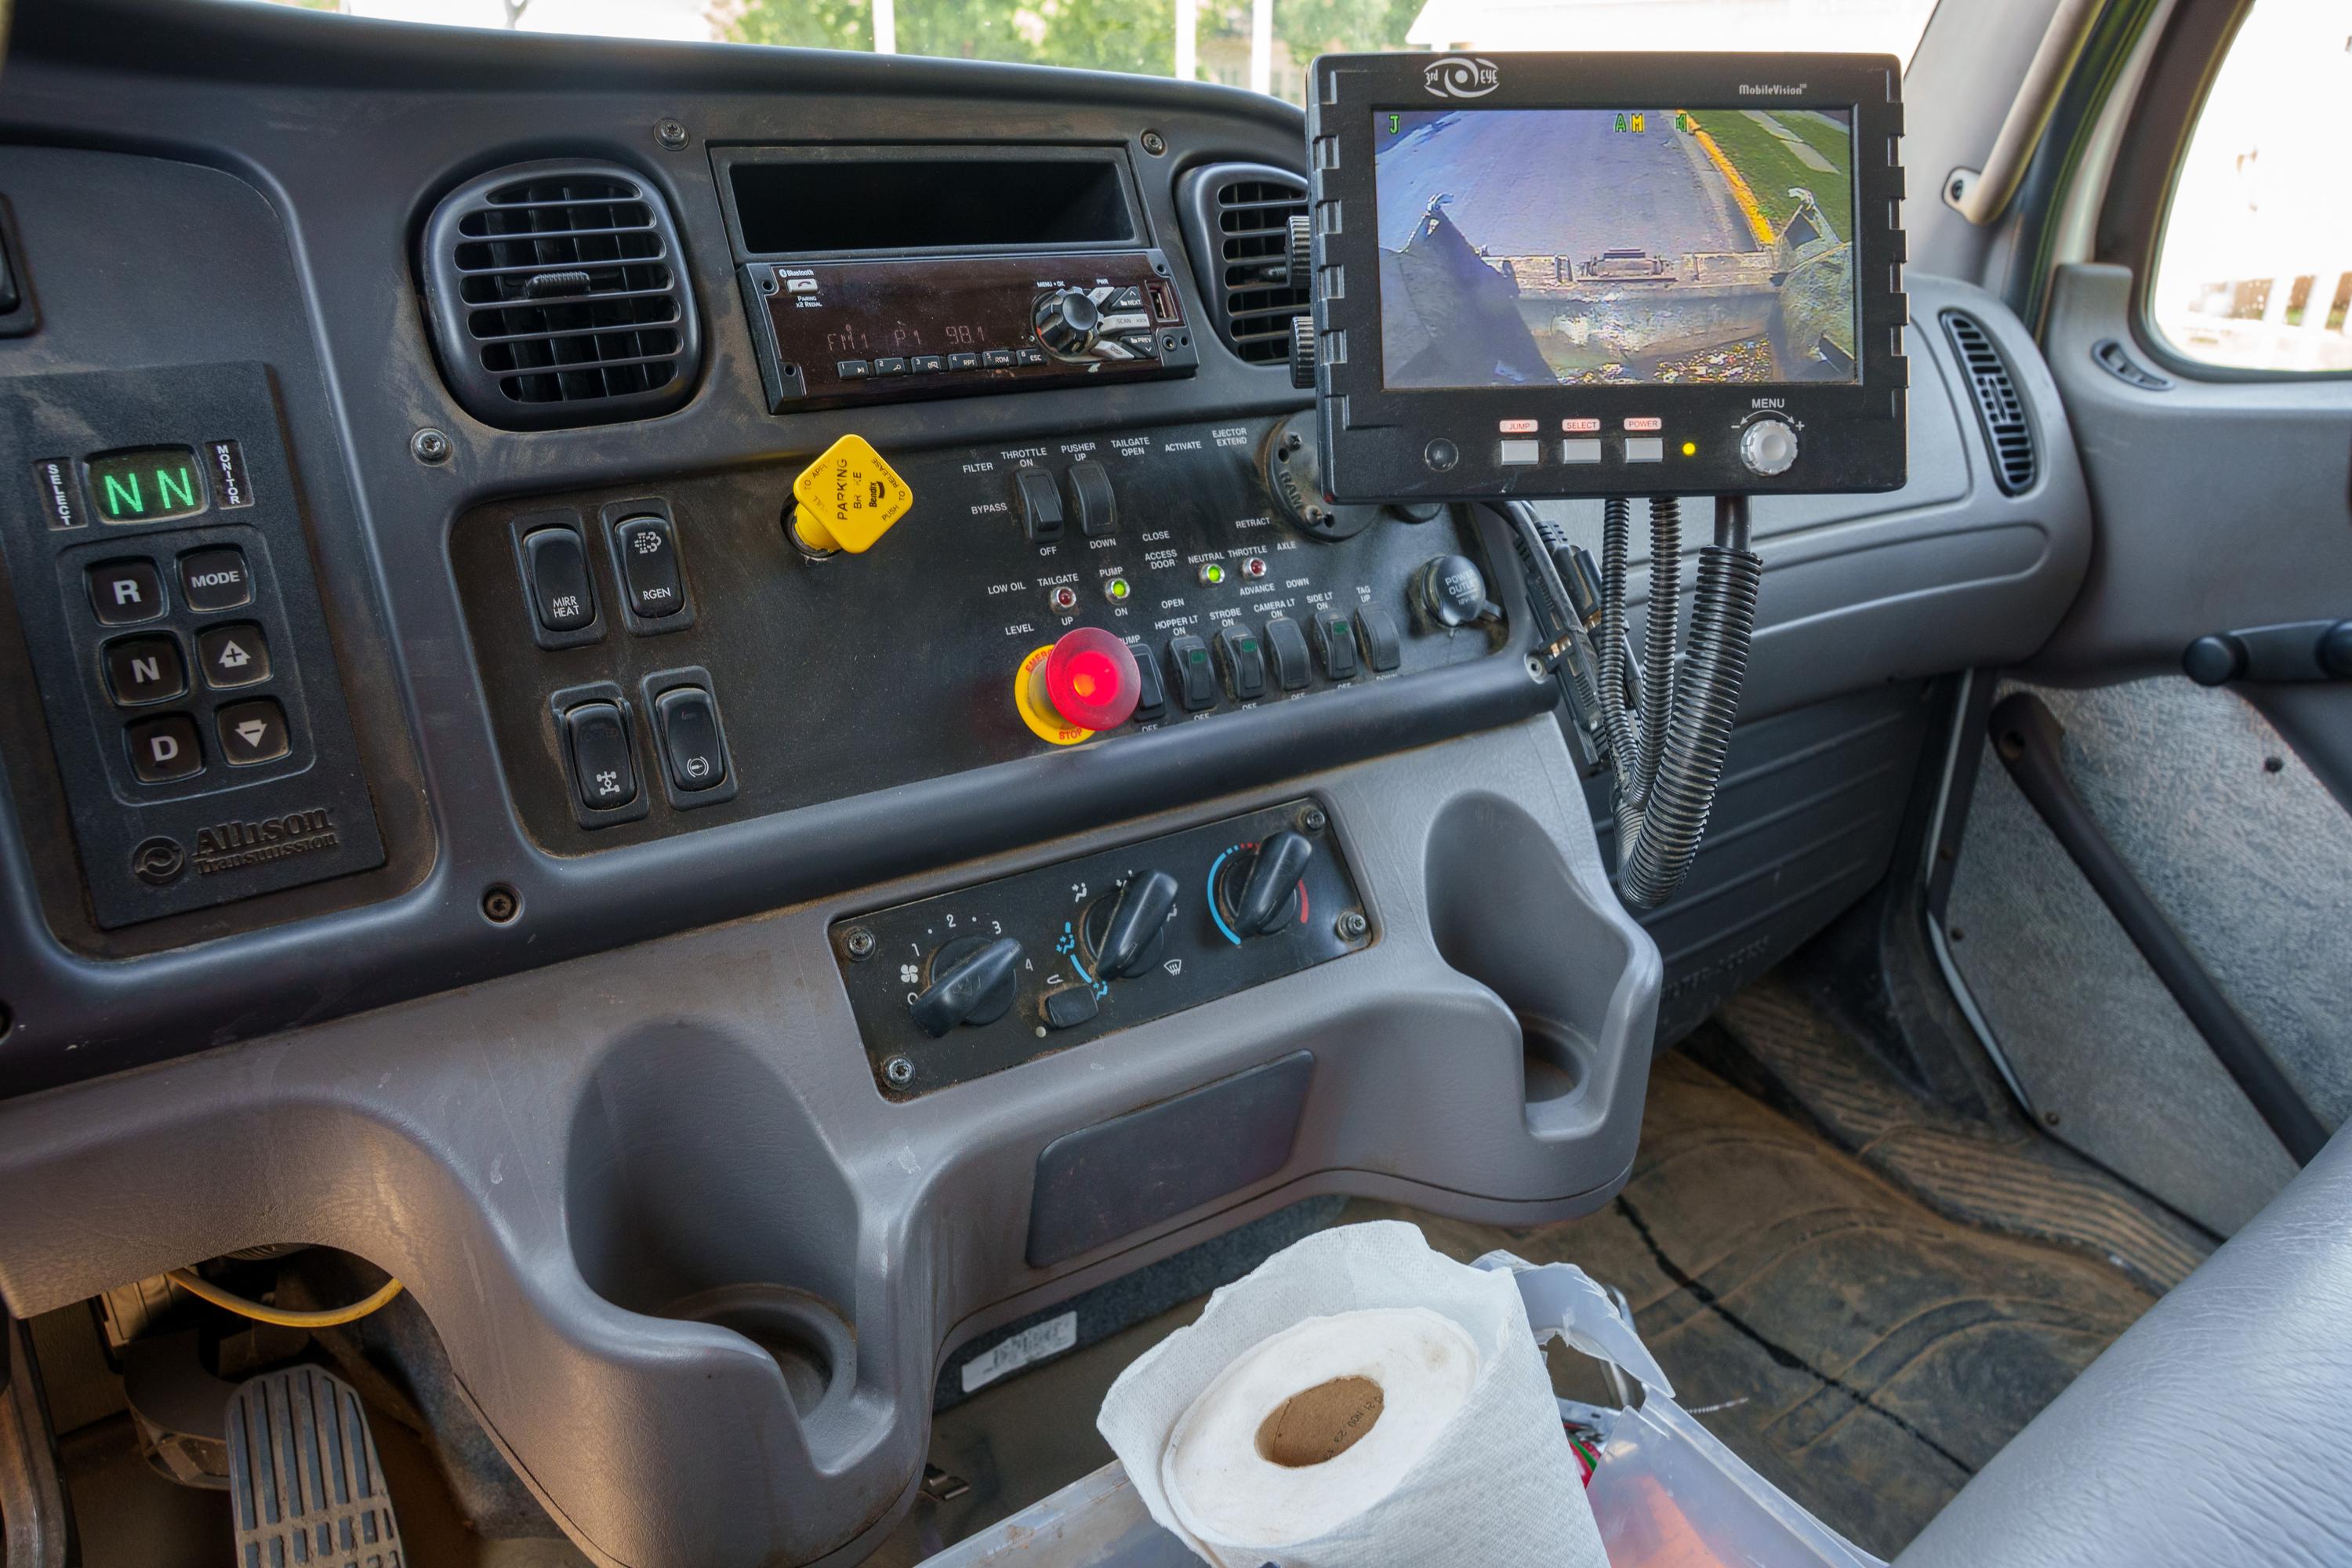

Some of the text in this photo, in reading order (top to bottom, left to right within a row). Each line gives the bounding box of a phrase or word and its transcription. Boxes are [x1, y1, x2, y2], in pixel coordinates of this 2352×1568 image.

[1425, 68, 1498, 85] 3rd EYE
[946, 325, 985, 345] 98.1
[1110, 346, 1123, 356] DISP
[1751, 398, 1785, 408] MENU
[1508, 422, 1531, 430] JUMP
[1566, 421, 1597, 430] SELECT
[1212, 427, 1247, 438] EJECTOR
[1110, 437, 1150, 449] TAILGATE
[1164, 441, 1202, 453] ACTIVATE
[1217, 436, 1247, 447] EXTEND
[1000, 447, 1047, 460] THROTTLE
[1061, 441, 1096, 455] PUSHER
[1121, 446, 1145, 457] OPEN
[1019, 458, 1033, 468] ON
[1074, 452, 1087, 462] UP
[963, 462, 994, 474] FILTER
[217, 445, 241, 506] MONITOR
[48, 464, 70, 525] SELECT
[837, 458, 848, 521] PARKING
[853, 471, 862, 509] BRKE
[871, 457, 906, 521] PUSH TO RELEASE
[1279, 470, 1303, 509] RAM
[971, 502, 1007, 515] BYPASS
[1236, 517, 1271, 529] RETRACT
[1142, 531, 1171, 542] CLOSE
[1089, 538, 1116, 549] DOWN
[1276, 541, 1297, 551] AXLE
[1040, 546, 1058, 557] OFF
[1145, 549, 1178, 561] ACCESS
[1188, 551, 1225, 564] NEUTRAL
[1228, 545, 1268, 558] THROTTLE
[1151, 559, 1176, 570] DOOR
[1099, 566, 1123, 578] PUMP
[191, 570, 241, 588] MODE
[1037, 573, 1080, 587] TAILGATE
[1286, 578, 1309, 589] DOWN
[112, 579, 142, 605] R
[643, 587, 671, 600] RGEN
[987, 582, 1026, 595] LOW OIL
[1240, 583, 1276, 596] ADVANCE
[1356, 586, 1371, 595] TAG
[553, 596, 577, 608] MIRR
[1161, 598, 1185, 609] OPEN
[1306, 592, 1333, 604] SIDE LT
[1360, 594, 1371, 603] UP
[554, 604, 580, 618] HEAT
[1254, 598, 1295, 613] CAMERA LT
[1316, 601, 1328, 611] ON
[1115, 608, 1128, 617] ON
[1209, 608, 1242, 621] STROBE
[1271, 610, 1283, 619] ON
[1061, 616, 1073, 626] UP
[1154, 615, 1198, 630] HOPPER LT
[1221, 618, 1234, 627] ON
[1005, 623, 1034, 636] LEVEL
[1173, 627, 1185, 637] ON
[132, 657, 161, 683] N
[1059, 728, 1083, 740] STOP
[151, 735, 179, 761] D
[192, 807, 333, 858] Allison
[946, 914, 956, 927] 2
[992, 920, 1002, 935] 3
[911, 943, 920, 956] 1
[1025, 958, 1033, 971] 4
